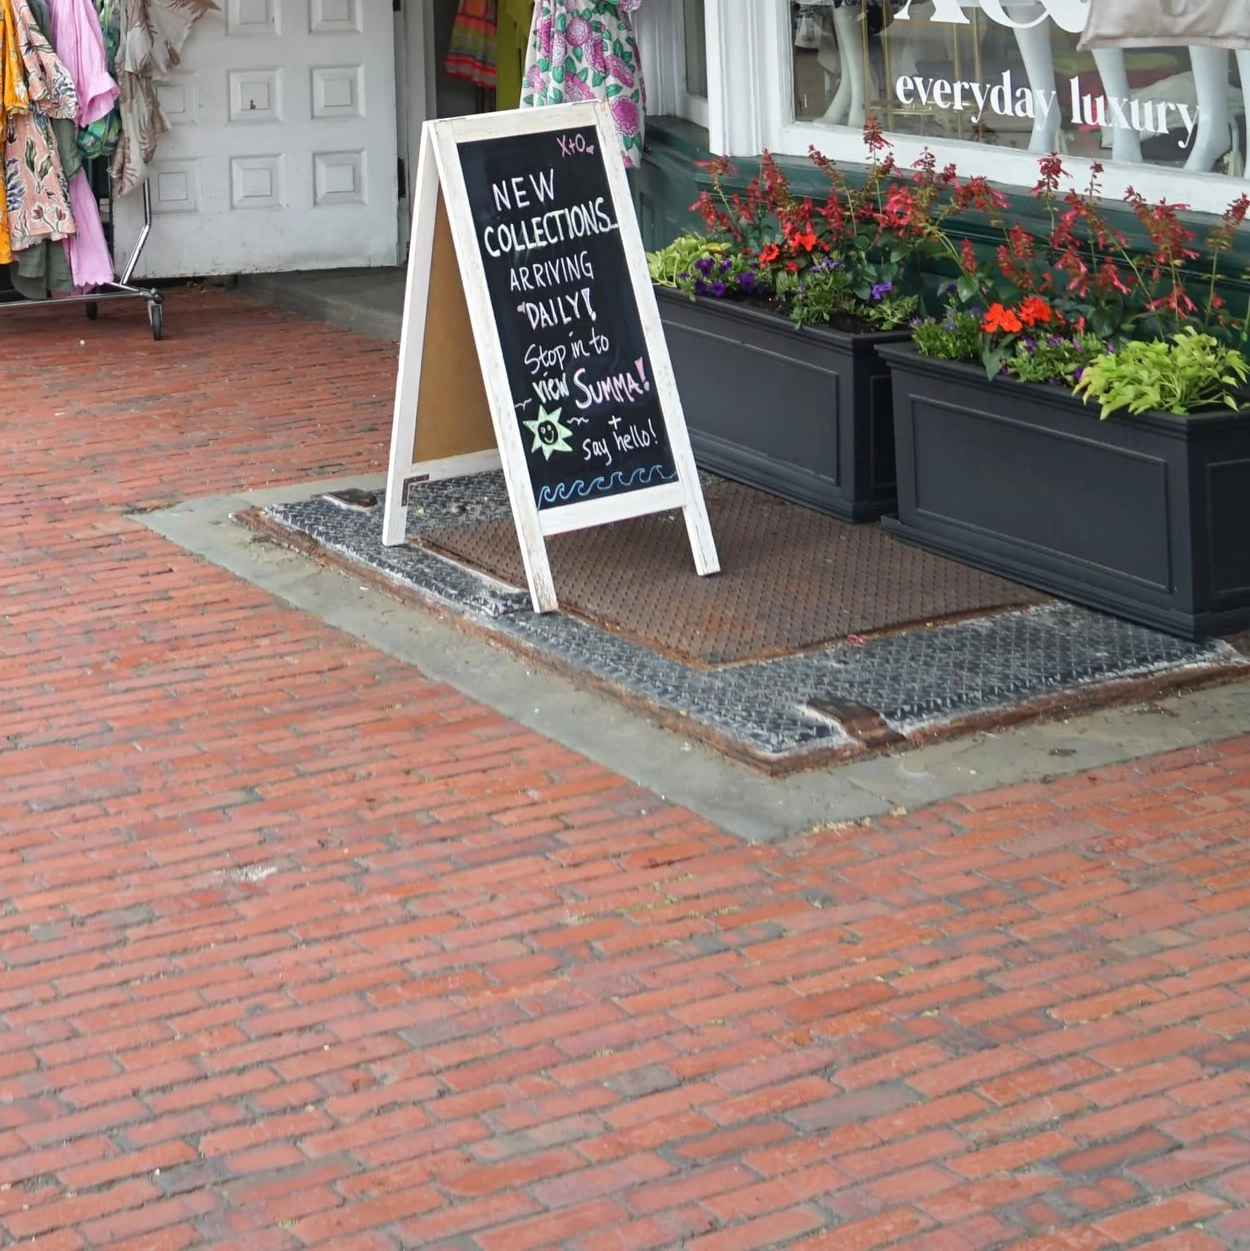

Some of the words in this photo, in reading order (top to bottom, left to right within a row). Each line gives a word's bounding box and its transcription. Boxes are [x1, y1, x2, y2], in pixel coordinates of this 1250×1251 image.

[895, 69, 1057, 130] everyday
[1069, 75, 1200, 149] luxury
[492, 168, 554, 212] NEW
[510, 250, 595, 292] ARRIVING
[525, 287, 597, 331] DAILY!
[524, 343, 567, 375] Stop
[569, 331, 590, 359] in
[588, 327, 610, 355] to
[582, 437, 613, 466] say
[613, 418, 658, 454] hello!
